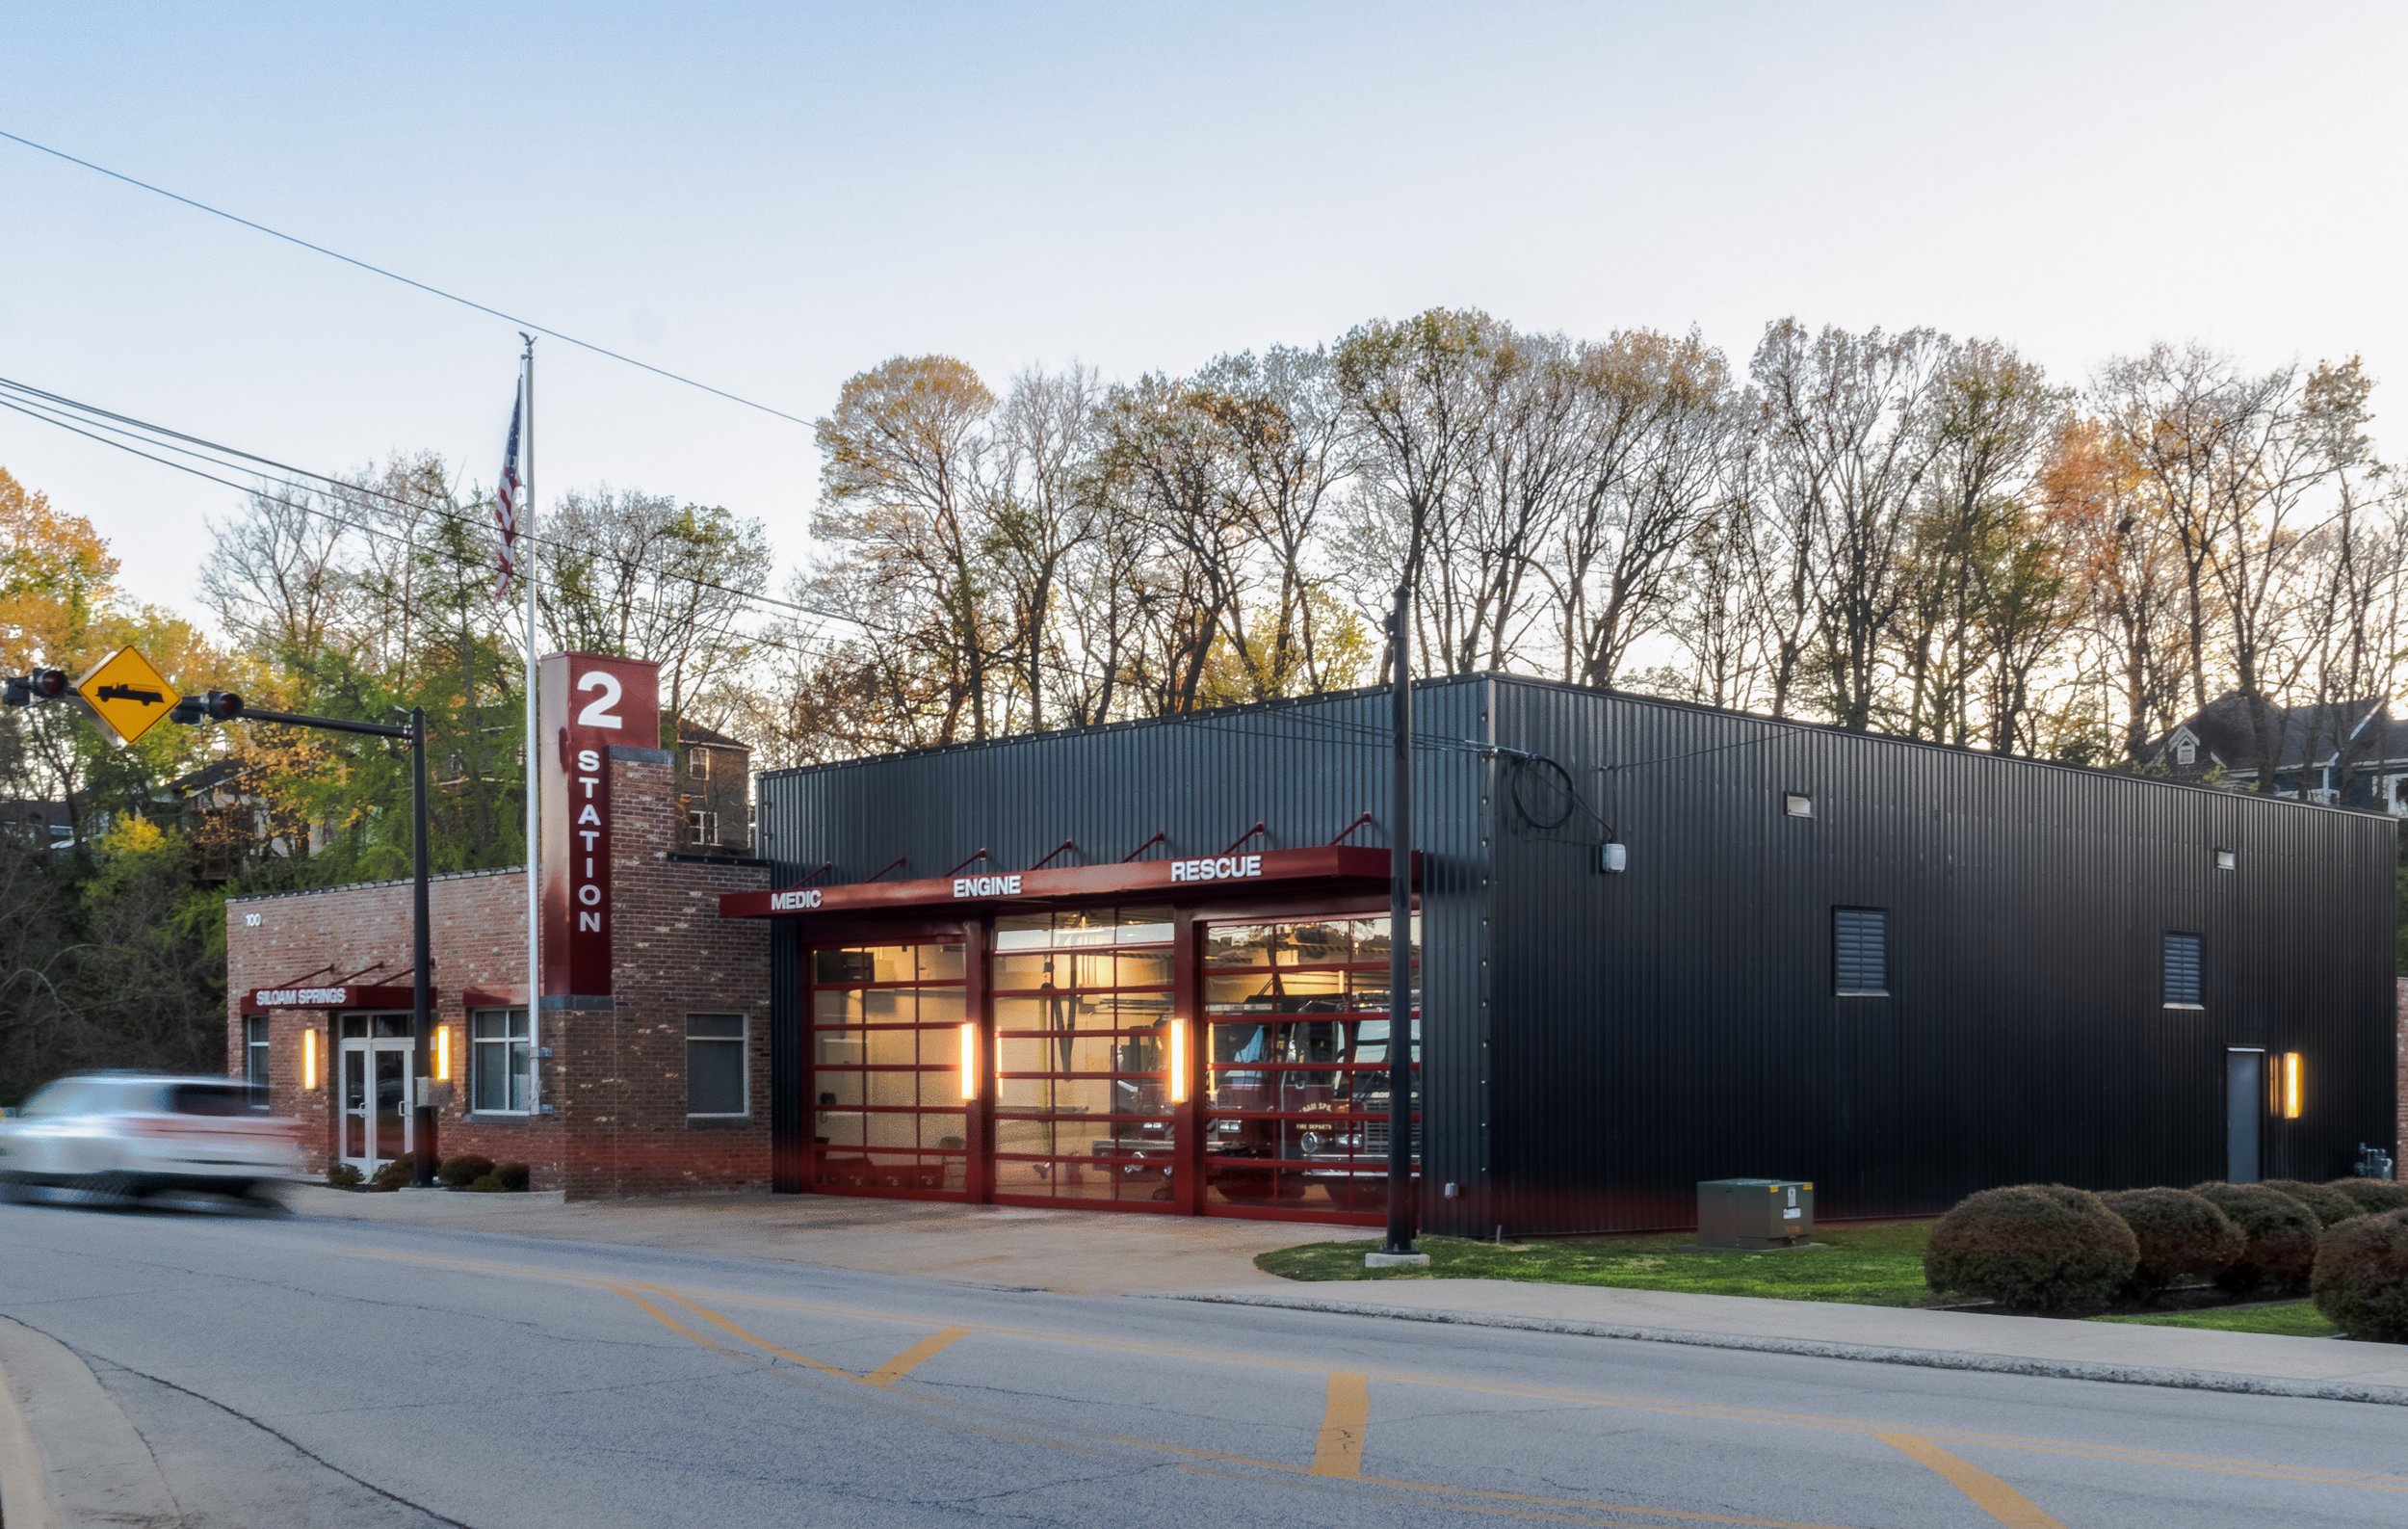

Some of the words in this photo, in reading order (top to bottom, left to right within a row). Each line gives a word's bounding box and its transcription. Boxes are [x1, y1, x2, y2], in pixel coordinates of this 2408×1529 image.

[577, 671, 623, 728] 2
[578, 750, 601, 933] STATION
[1170, 855, 1262, 883] RESCUE
[953, 875, 1022, 898] ENGINE
[771, 889, 822, 909] MEDIC
[246, 913, 261, 927] 100
[256, 989, 297, 1006] SILOAM
[298, 988, 346, 1005] SPRINGS
